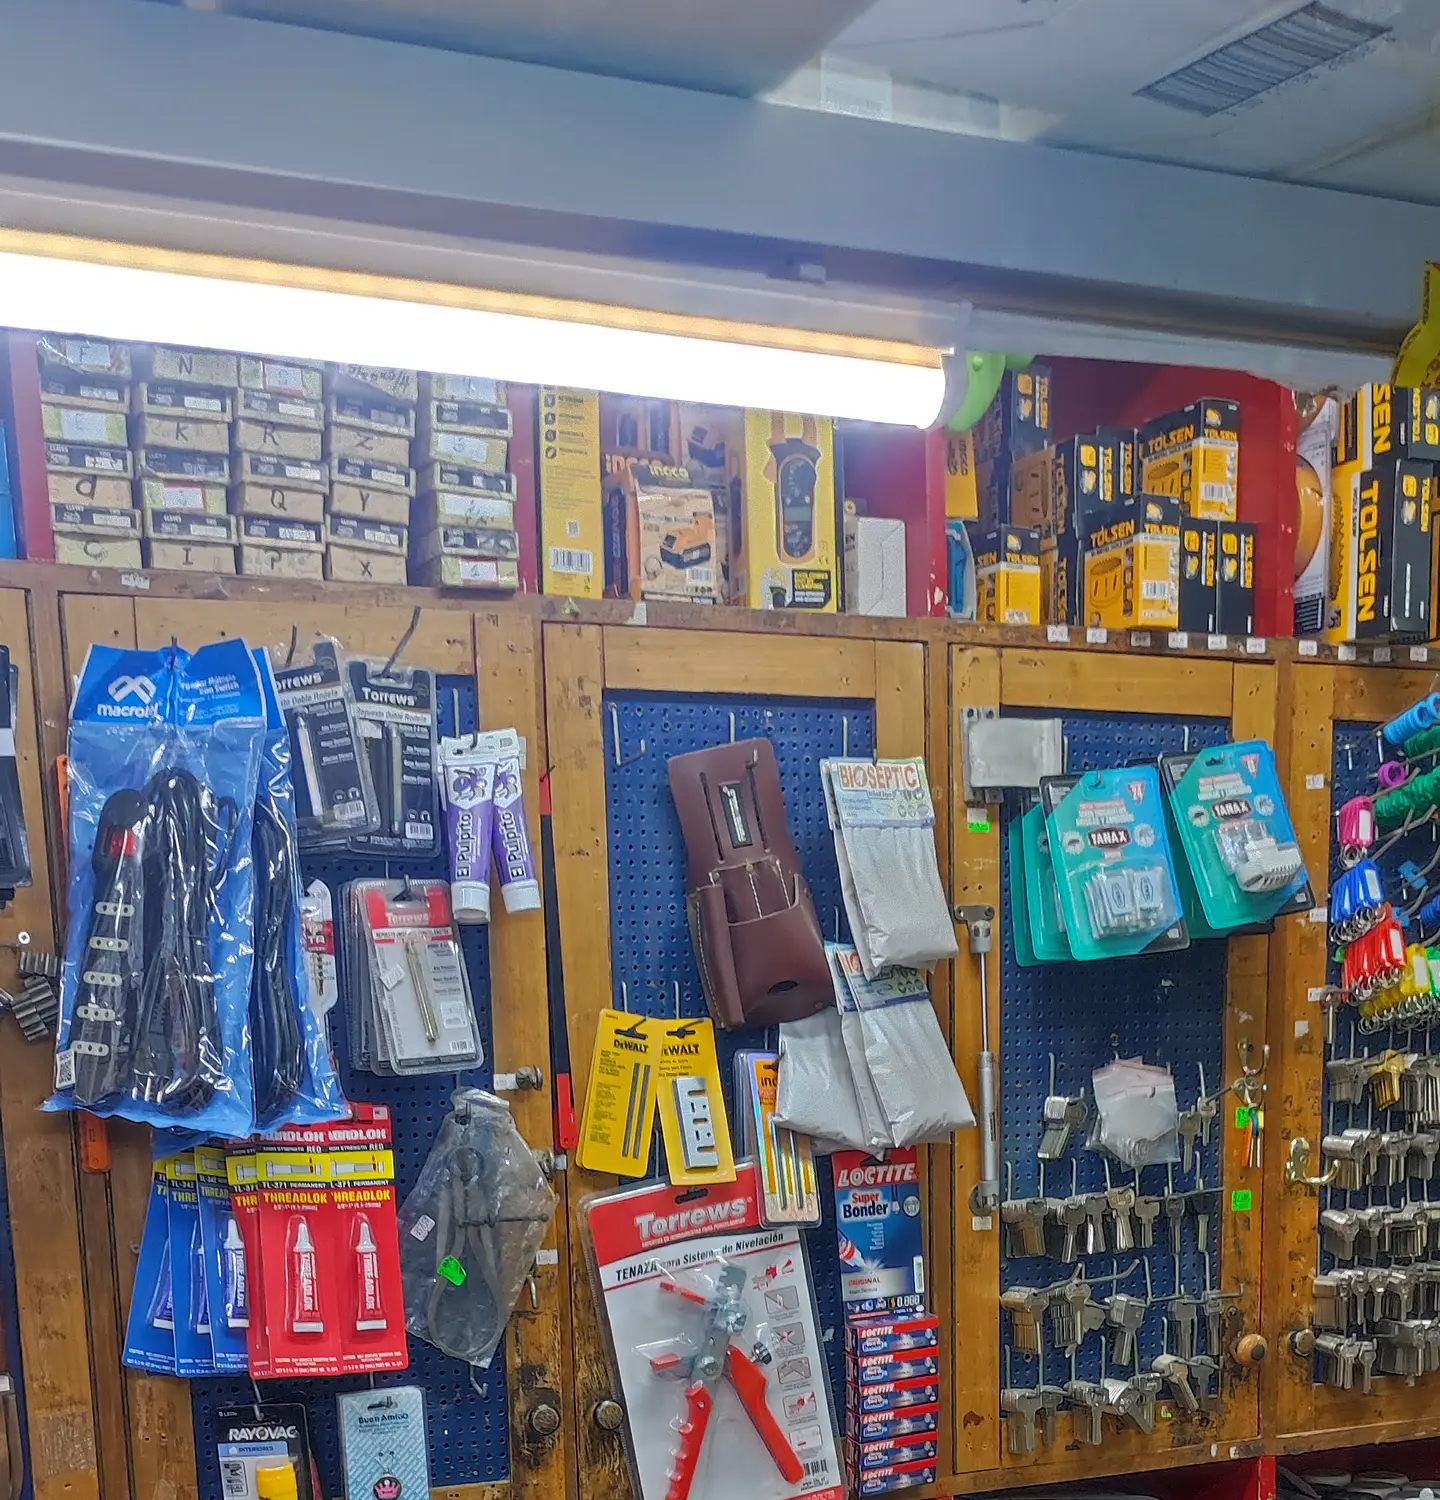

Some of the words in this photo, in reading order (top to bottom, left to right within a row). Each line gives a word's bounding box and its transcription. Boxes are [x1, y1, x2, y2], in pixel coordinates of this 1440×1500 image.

[179, 356, 193, 375] N
[1373, 384, 1392, 454] SEN
[176, 421, 188, 441] K
[263, 425, 279, 446] R
[1149, 425, 1194, 454] TOLSEN
[1204, 429, 1237, 441] TOLSEN
[271, 488, 287, 511] Q
[359, 491, 371, 511] Y
[1090, 519, 1136, 547] TOLSEN
[1144, 524, 1180, 535] TOLSEN
[976, 552, 997, 566] SEN
[1005, 552, 1039, 565] TOLSEN
[1358, 480, 1380, 622] TOLSEN
[359, 560, 373, 577] X
[361, 687, 416, 706] Torrews
[840, 764, 918, 789] BIOSEPTIC
[1215, 802, 1251, 817] TANAX
[457, 812, 473, 863] Pulpito
[500, 812, 523, 862] Pulpito
[1090, 830, 1127, 845] TANAX
[661, 1043, 700, 1056] EWALT
[838, 1163, 917, 1187] LOCTITE
[201, 1186, 230, 1198] THREAD
[263, 1191, 328, 1204] THREADLOK
[852, 1192, 880, 1204] Super
[843, 1201, 889, 1219] Bonder
[634, 1199, 747, 1241] Torrews
[616, 1263, 657, 1282] TENAZA
[722, 1245, 733, 1255] de
[736, 1231, 784, 1252] Nivelación
[302, 1253, 312, 1311] THREADLOK
[363, 1253, 374, 1311] THREADLOK
[358, 1413, 378, 1425] Buen
[229, 1425, 297, 1441] RAYOVAC
